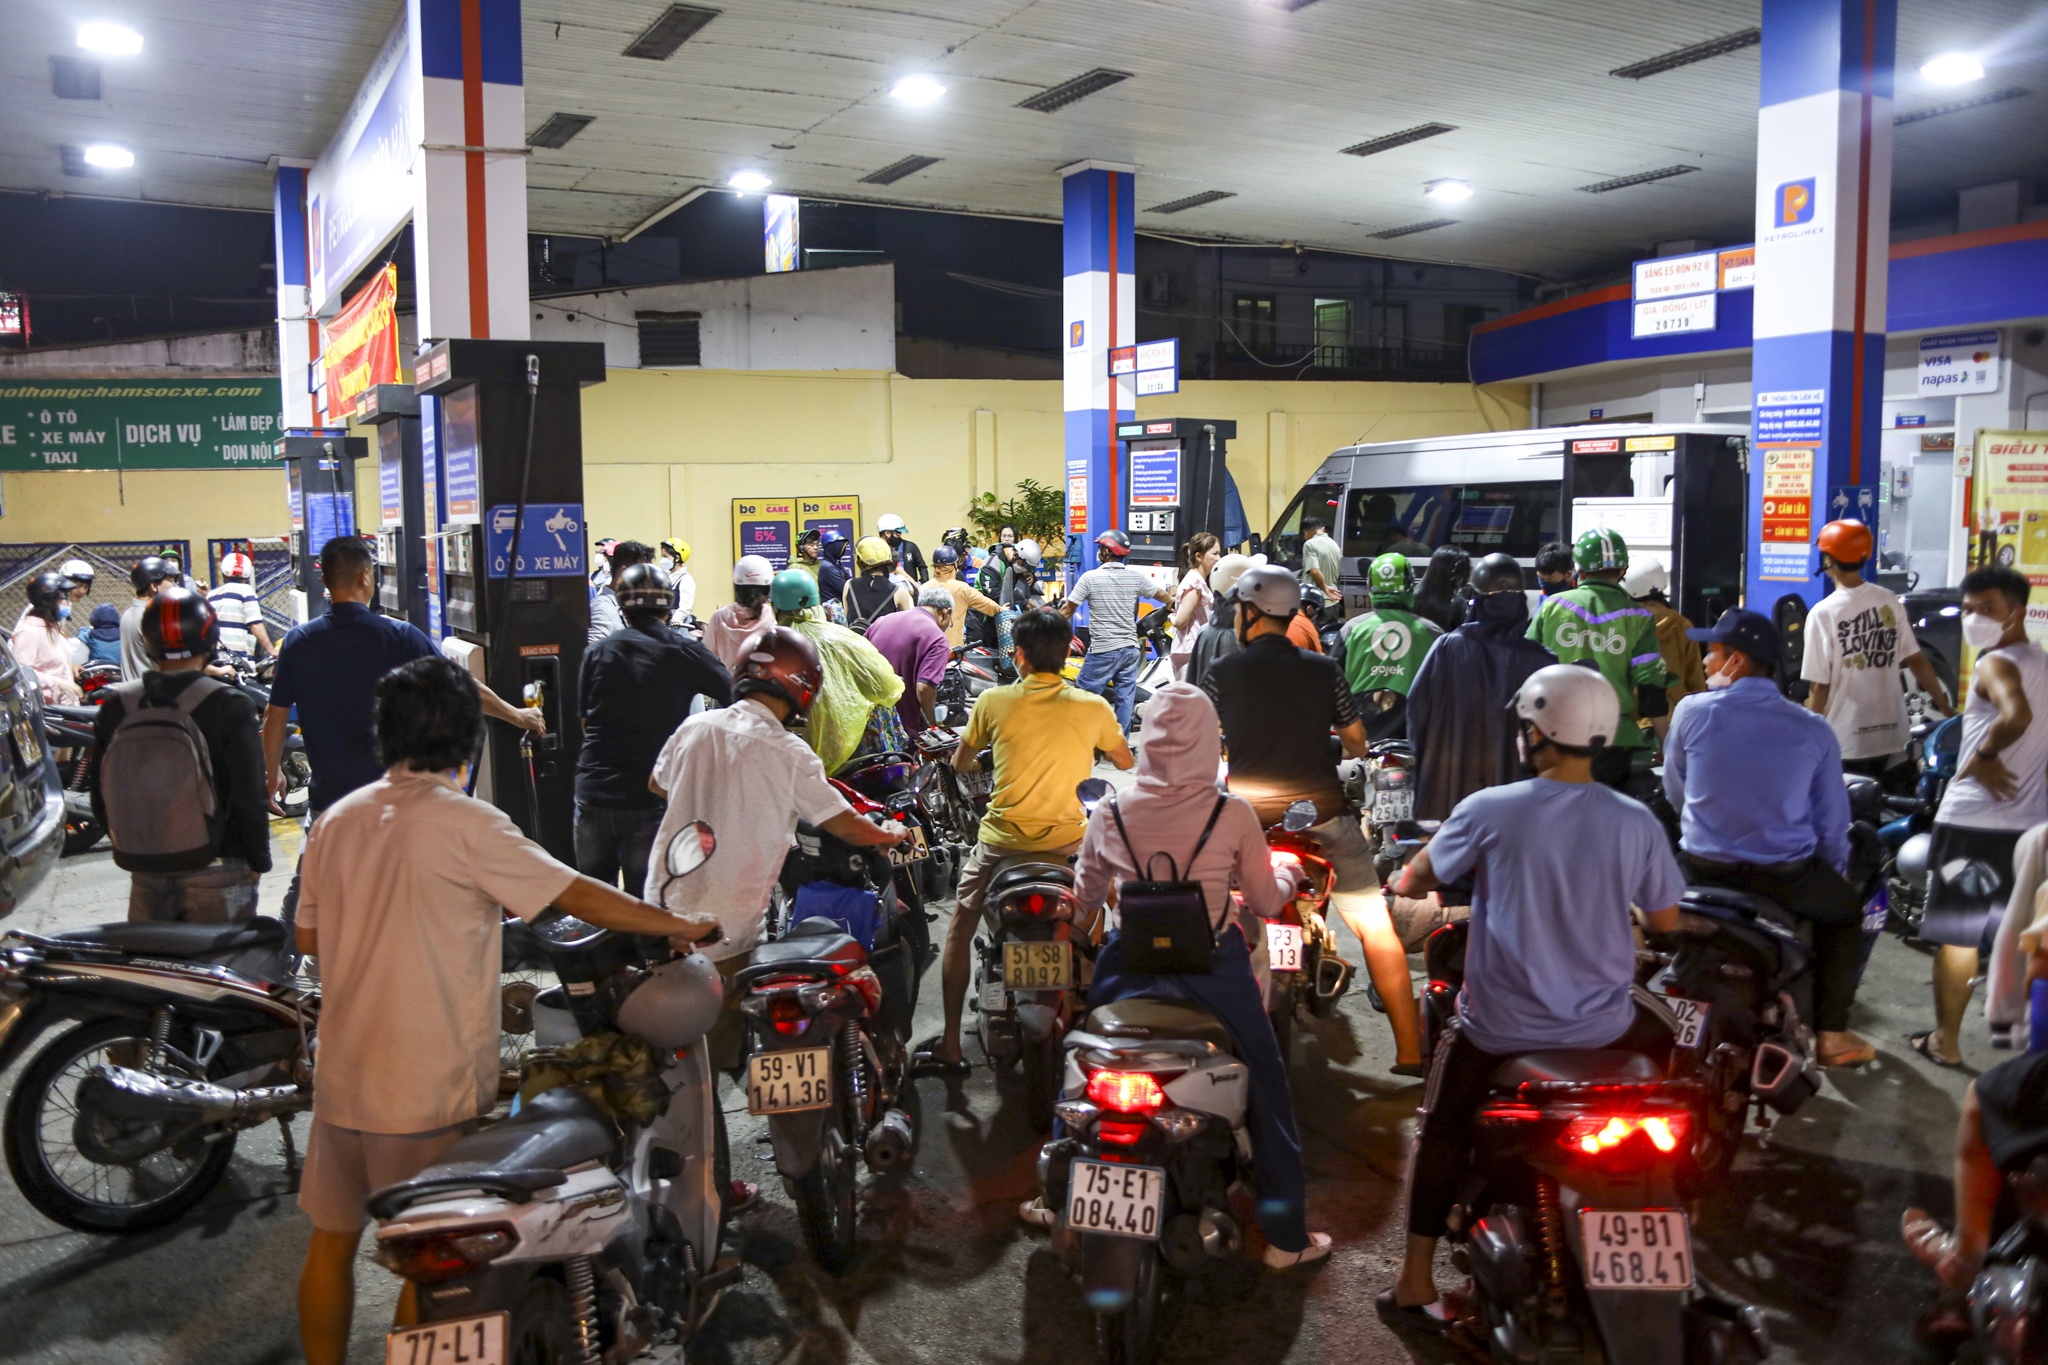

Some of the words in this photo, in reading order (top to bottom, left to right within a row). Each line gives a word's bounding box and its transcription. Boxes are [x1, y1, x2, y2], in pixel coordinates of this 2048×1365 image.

[1764, 226, 1825, 243] PETROLIMEX
[1675, 263, 1691, 275] RON
[1692, 261, 1702, 272] 92
[1656, 317, 1689, 331] 20730
[1925, 356, 1952, 367] VISA
[1922, 373, 1958, 387] napas
[40, 409, 52, 424] Ô
[56, 409, 78, 424] TÔ
[221, 412, 247, 431] LÀM
[250, 415, 273, 434] ĐẸP
[0, 425, 16, 444] E
[41, 431, 64, 444] XE
[69, 429, 106, 444] MÁY
[126, 424, 171, 448] DỊCH
[176, 424, 201, 447] VỤ
[223, 444, 248, 464] DỌN
[251, 441, 272, 463] NỘI
[1988, 439, 2039, 455] SIÊU
[42, 451, 78, 464] TAXI
[739, 504, 756, 514] be
[803, 503, 820, 512] be
[1778, 501, 1793, 514] CẤM
[1793, 501, 1806, 514] LỬA
[755, 530, 777, 542] 5%
[495, 555, 505, 572] Ô
[508, 555, 525, 571] Ô
[534, 556, 551, 570] XE
[553, 553, 579, 569] MÁY
[1838, 606, 1884, 638] STILL
[1555, 622, 1626, 655] Grab
[1839, 628, 1897, 657] LOVING
[522, 647, 538, 656] XĂNG
[539, 646, 551, 655] RON
[1371, 664, 1405, 677] gojek
[1381, 792, 1412, 806] 64-B1
[1274, 929, 1292, 946] P3
[1013, 945, 1061, 964] 51-S8
[129, 958, 212, 975] SIRIUS
[1013, 967, 1061, 986] 8092
[760, 1053, 816, 1081] 59-V1
[754, 1079, 827, 1110] 141.36
[1086, 1165, 1148, 1200] 75-E1
[1072, 1196, 1155, 1234] 084.40
[1599, 1215, 1672, 1247] 49-B1
[1592, 1251, 1686, 1284] 468.41
[406, 1321, 485, 1365] 77-L1
